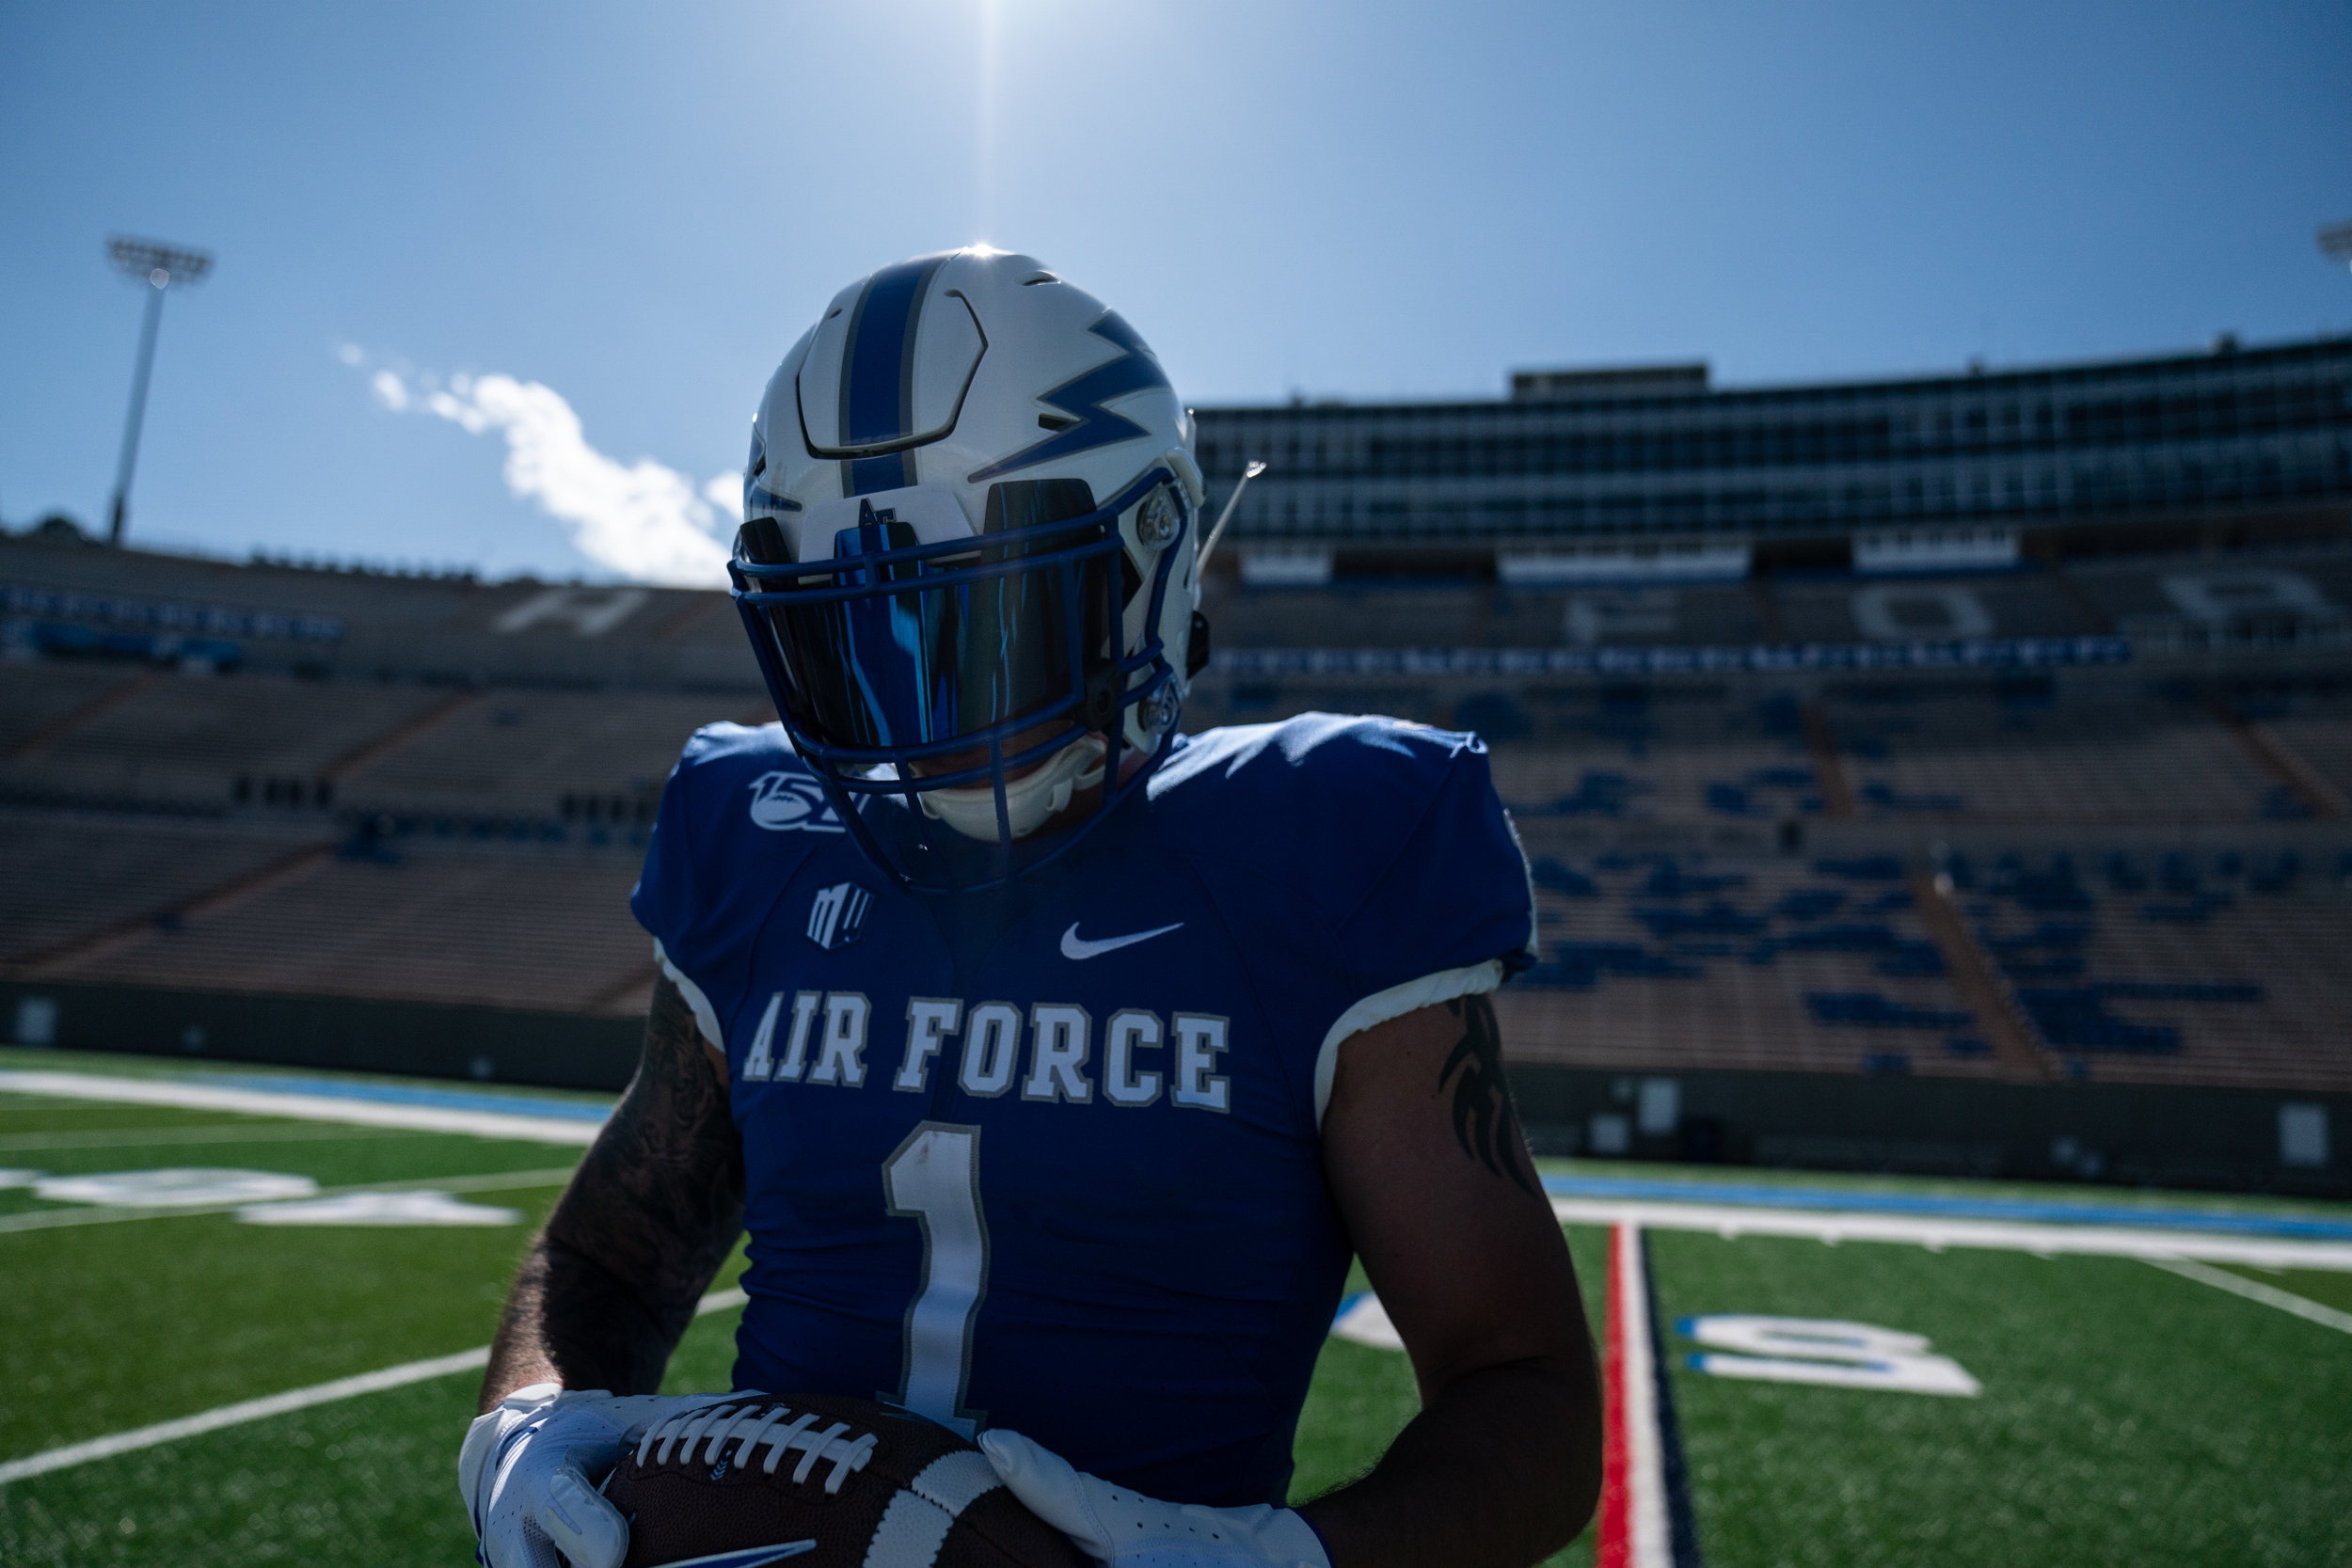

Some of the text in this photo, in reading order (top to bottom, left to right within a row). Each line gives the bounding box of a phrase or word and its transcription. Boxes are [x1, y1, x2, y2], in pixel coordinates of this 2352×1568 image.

[741, 990, 1231, 1115] AIR FORCE
[875, 1119, 992, 1444] 1
